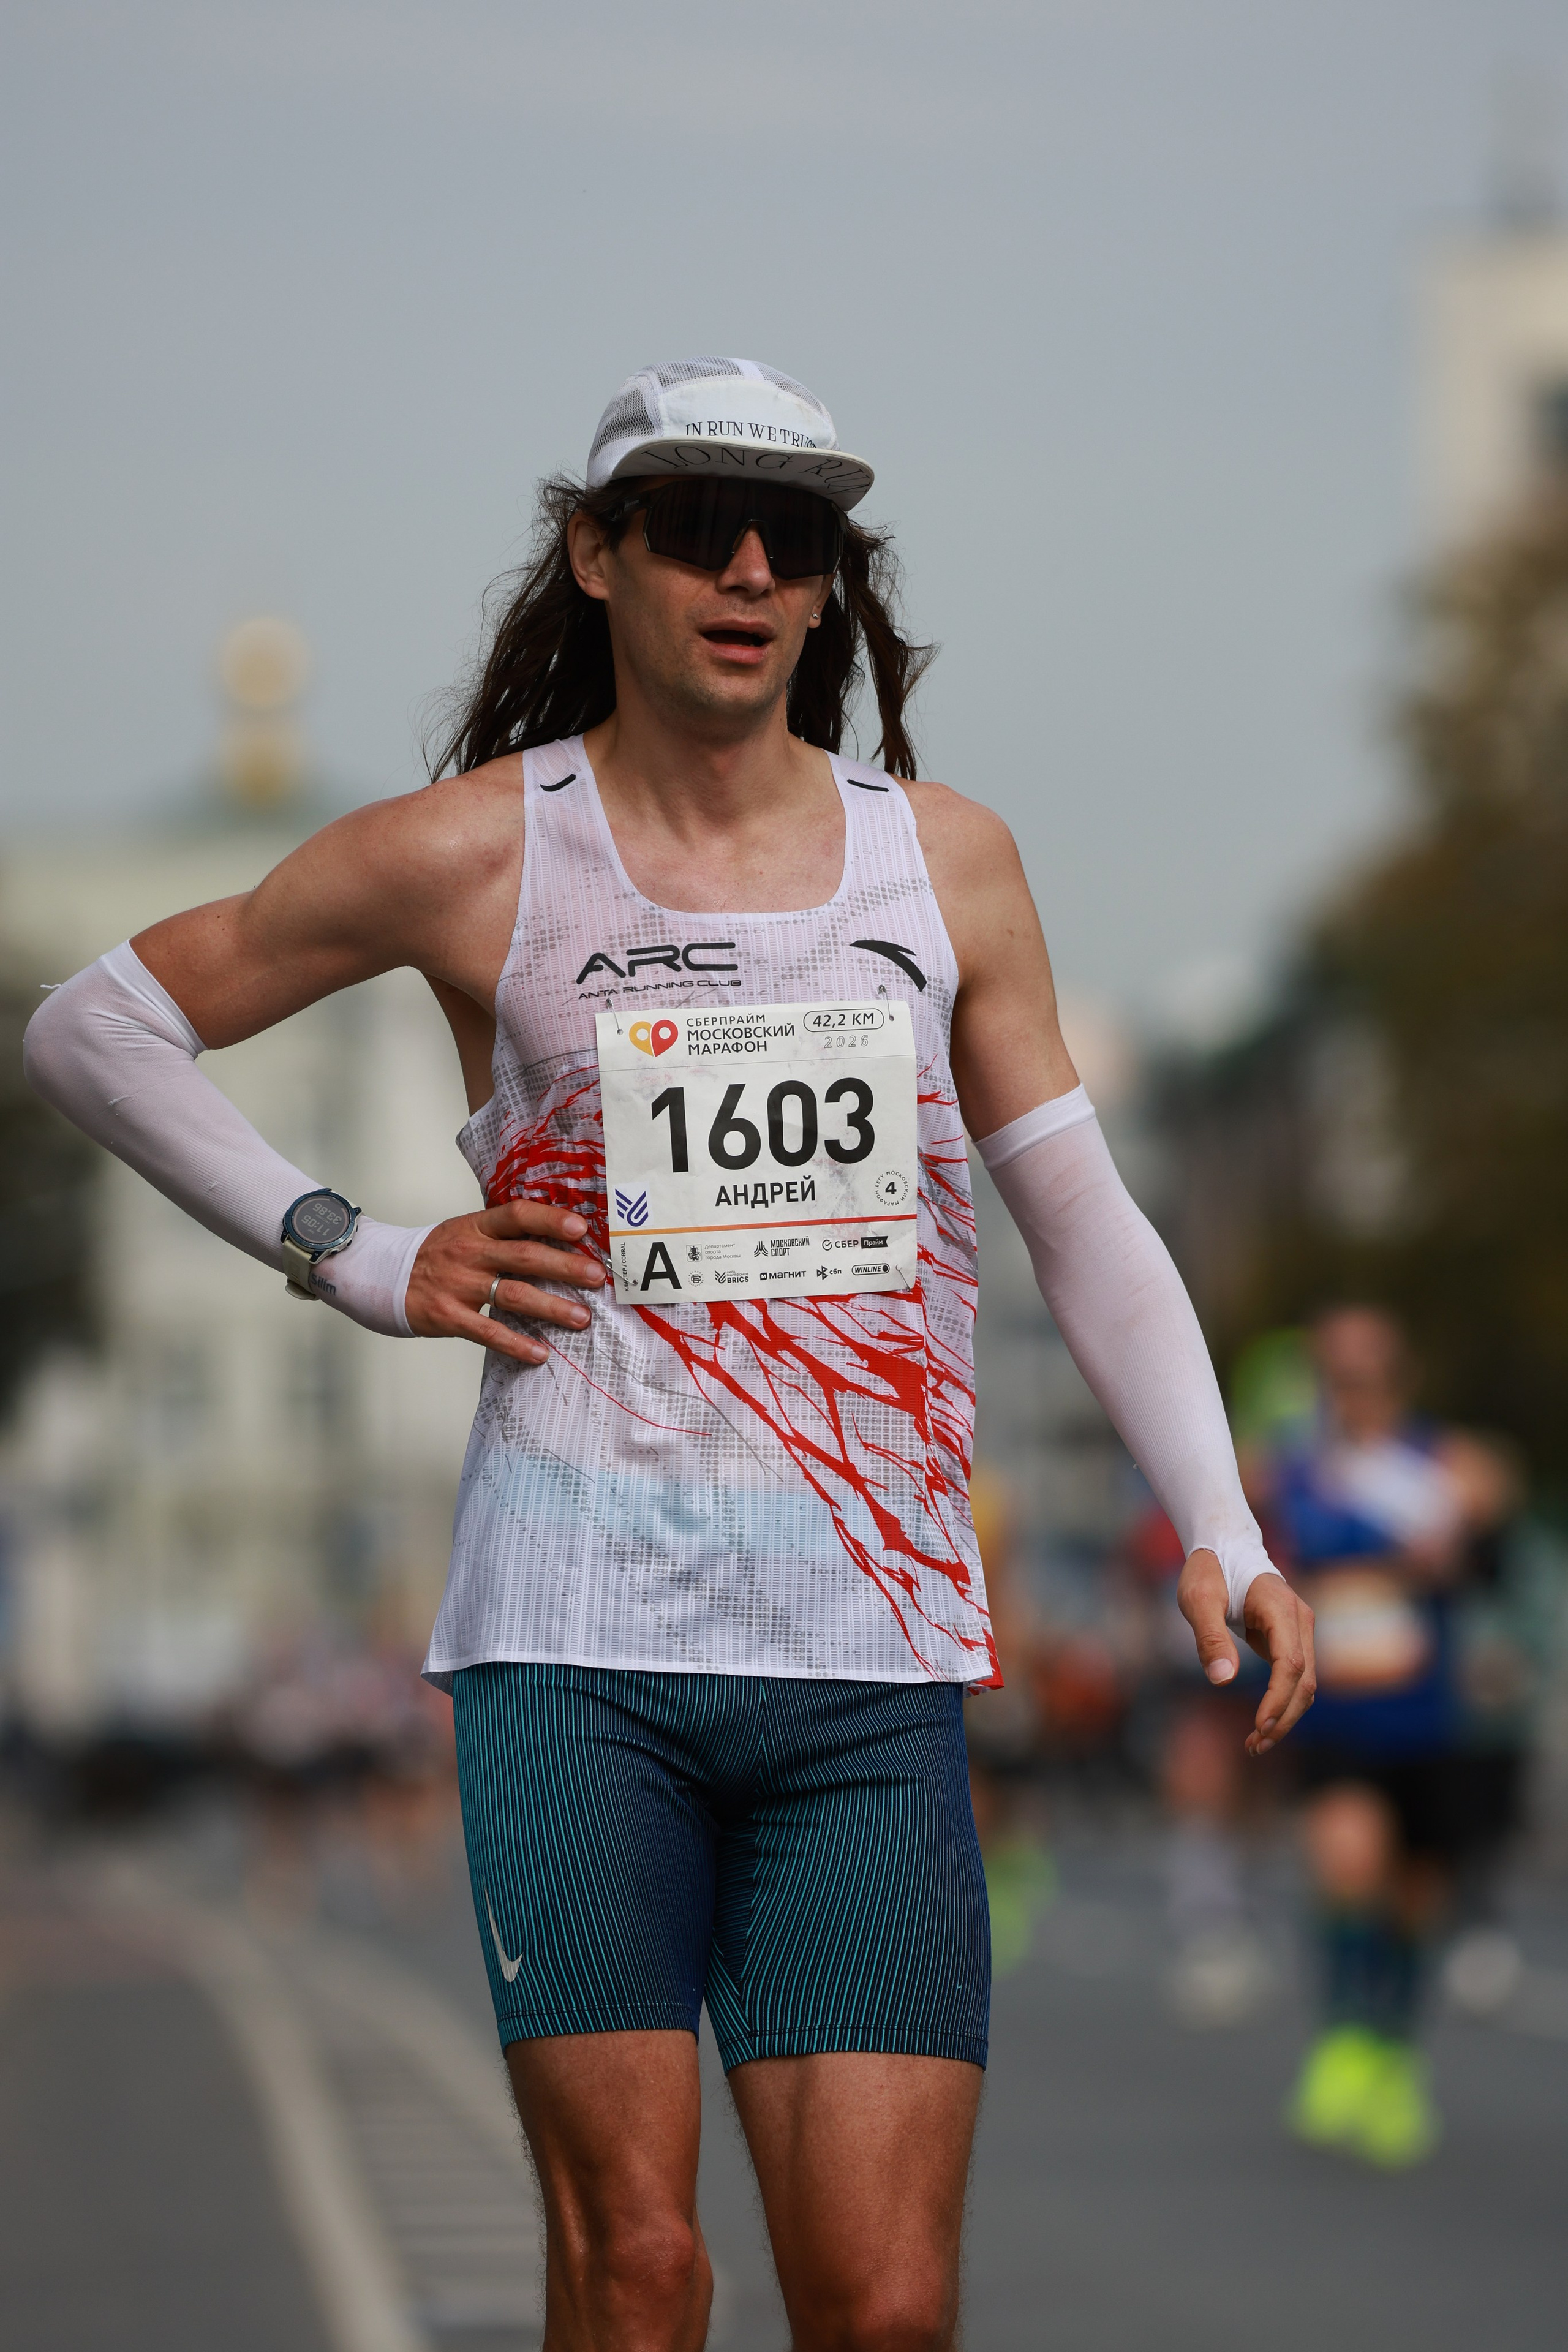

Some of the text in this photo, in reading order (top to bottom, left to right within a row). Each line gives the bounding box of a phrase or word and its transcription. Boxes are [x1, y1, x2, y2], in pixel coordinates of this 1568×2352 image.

[685, 421, 703, 436] IN
[707, 421, 744, 436] RUN
[747, 423, 777, 442] WE
[641, 445, 870, 495] LONG RUN
[576, 942, 738, 985] ARC
[578, 989, 618, 1000] ANTA
[623, 980, 693, 993] RUNNING
[686, 1014, 766, 1027] СБЕРПРАЙМ
[813, 1013, 874, 1028] 42,2 КМ
[687, 1022, 795, 1041] МОСКОВСКИЙ
[688, 1040, 767, 1056] МАРАФОН
[824, 1035, 869, 1049] 2026
[651, 1077, 875, 1173] 1603
[715, 1175, 816, 1209] АНДРЕЙ
[875, 1170, 908, 1206] БЕГУ МОСКОВСКИЙ МАРАФОН
[885, 1181, 897, 1195] 4
[312, 1203, 342, 1224] 33.86
[301, 1215, 330, 1236] 11:05
[771, 1236, 810, 1248] МОСКОВСКИЙ
[834, 1240, 859, 1248] СБЕР
[771, 1248, 790, 1257] СПОРТ
[639, 1242, 682, 1291] А
[769, 1270, 807, 1280] магнит
